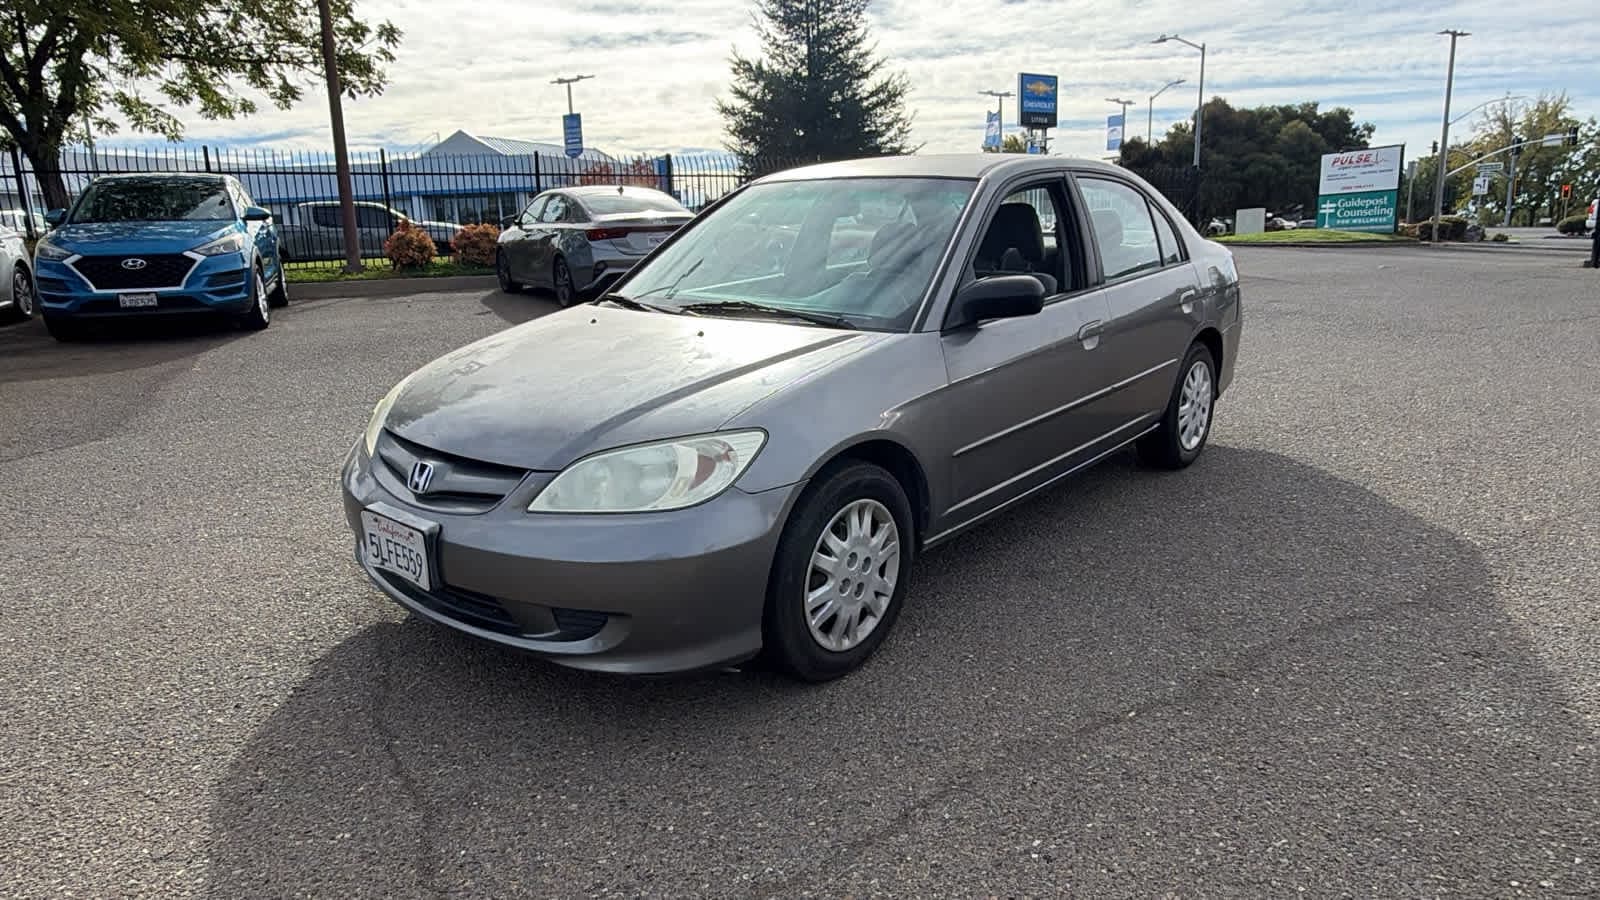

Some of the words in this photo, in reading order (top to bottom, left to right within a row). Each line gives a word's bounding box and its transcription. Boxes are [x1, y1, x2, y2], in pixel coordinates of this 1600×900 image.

[1331, 153, 1373, 167] PULSE
[1337, 196, 1388, 208] Guidepost
[1336, 206, 1394, 218] Counseling
[368, 532, 423, 577] 5LFE559
